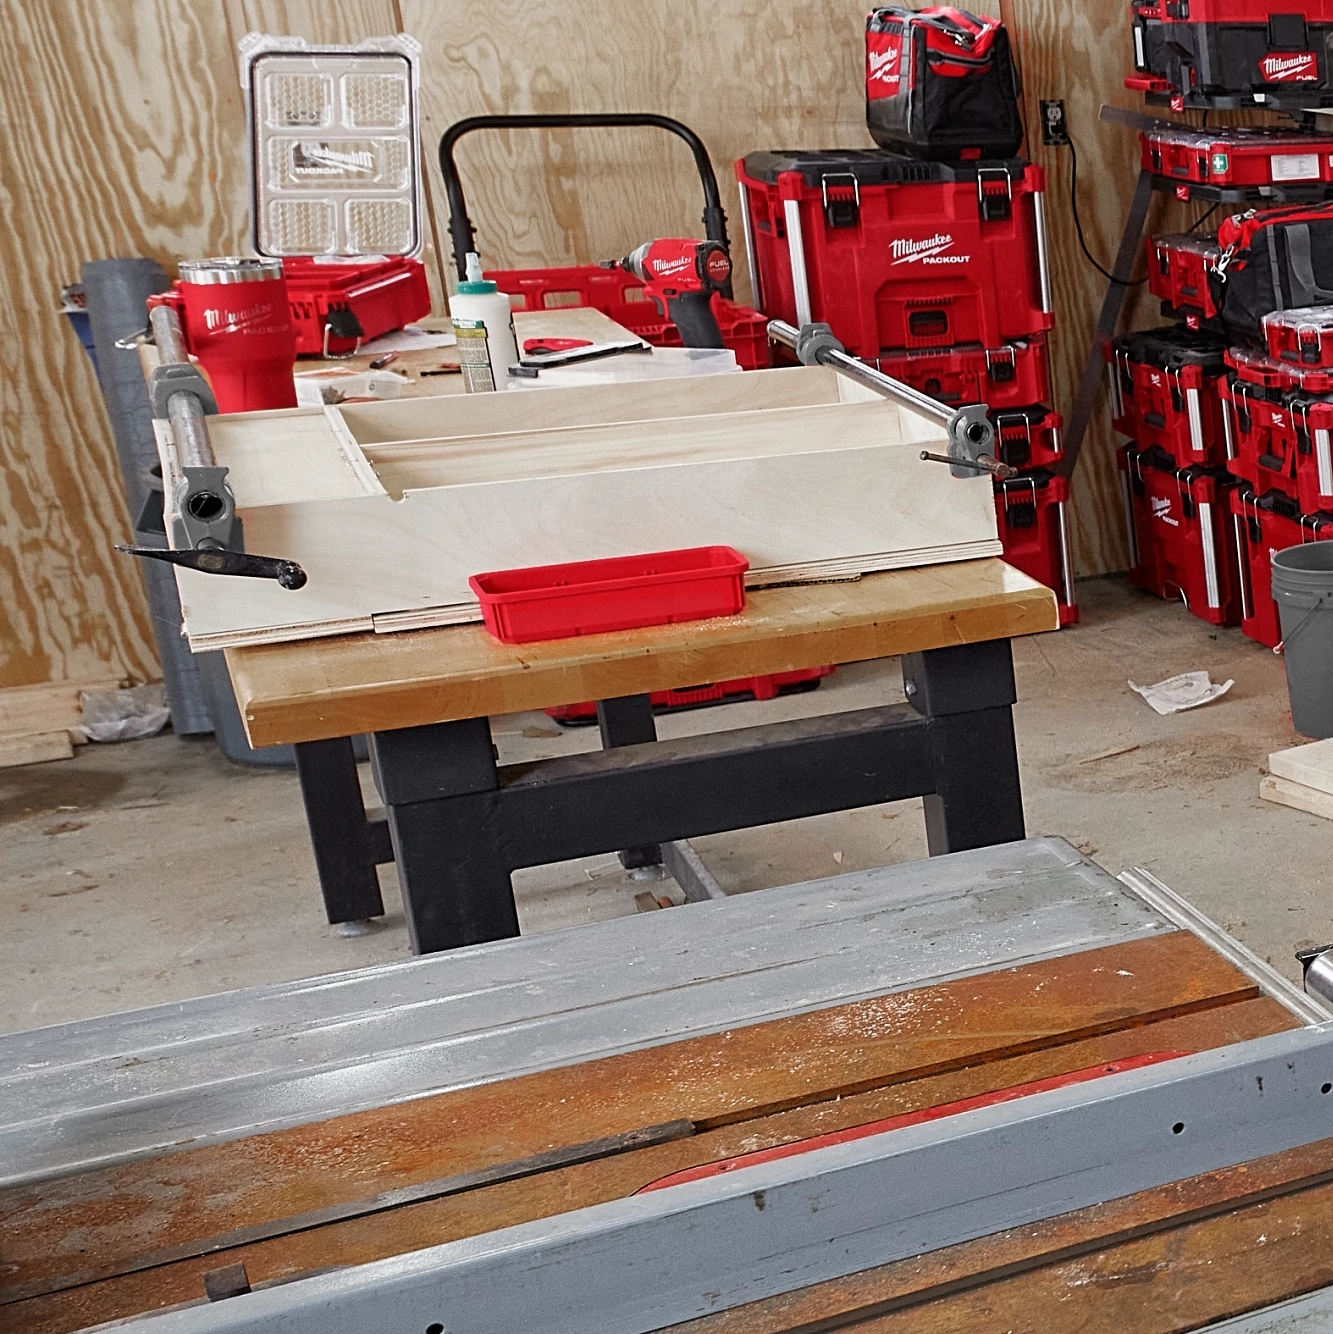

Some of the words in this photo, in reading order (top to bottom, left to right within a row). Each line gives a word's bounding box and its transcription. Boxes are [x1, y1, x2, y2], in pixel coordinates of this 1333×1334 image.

[1263, 54, 1312, 74] Milwaukee
[888, 234, 953, 259] Milwaukee
[652, 256, 692, 272] Milwaukee
[923, 256, 970, 265] PACKOUT
